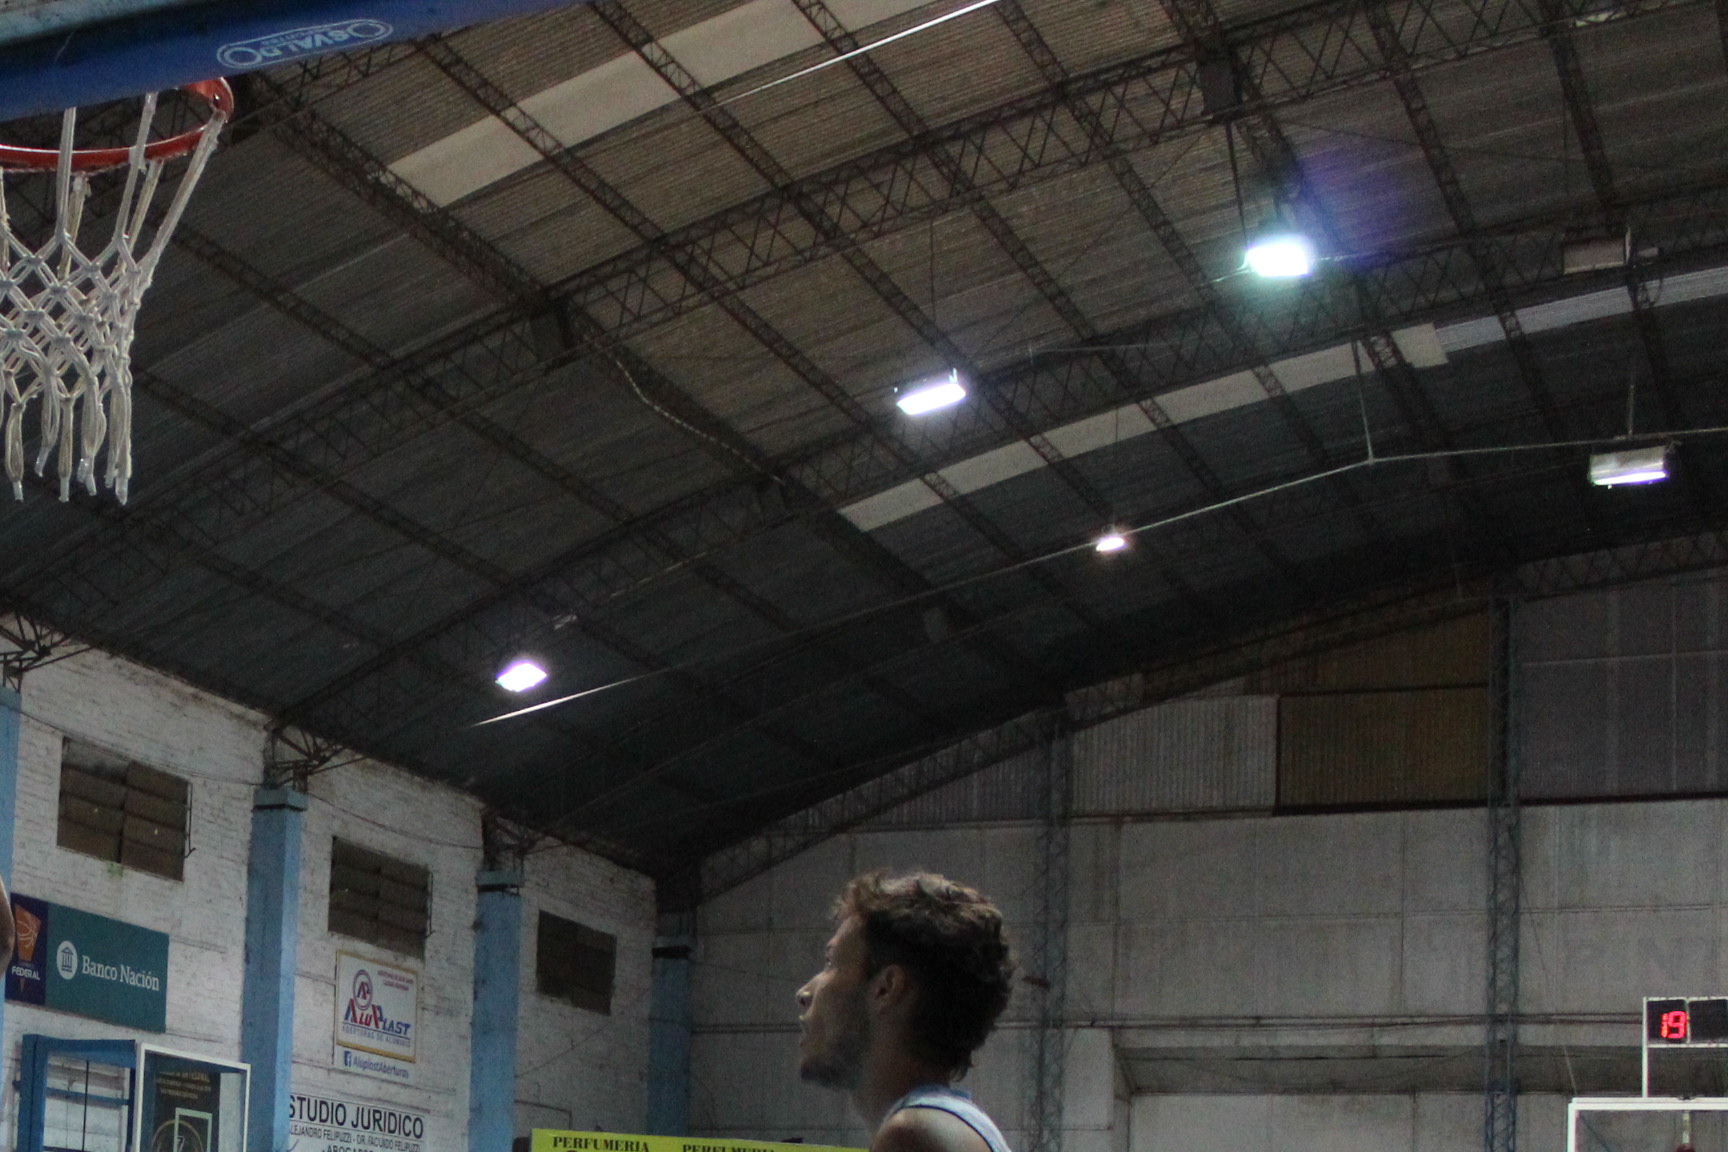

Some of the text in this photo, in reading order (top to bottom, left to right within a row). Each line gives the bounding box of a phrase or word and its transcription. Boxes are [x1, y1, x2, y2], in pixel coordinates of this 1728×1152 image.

[11, 965, 41, 981] FEDERAL
[82, 954, 161, 991] Banco Nación
[290, 1124, 323, 1139] LEJANDRO
[323, 1129, 353, 1144] FELIPUZZI
[351, 1106, 423, 1139] JURIDICO
